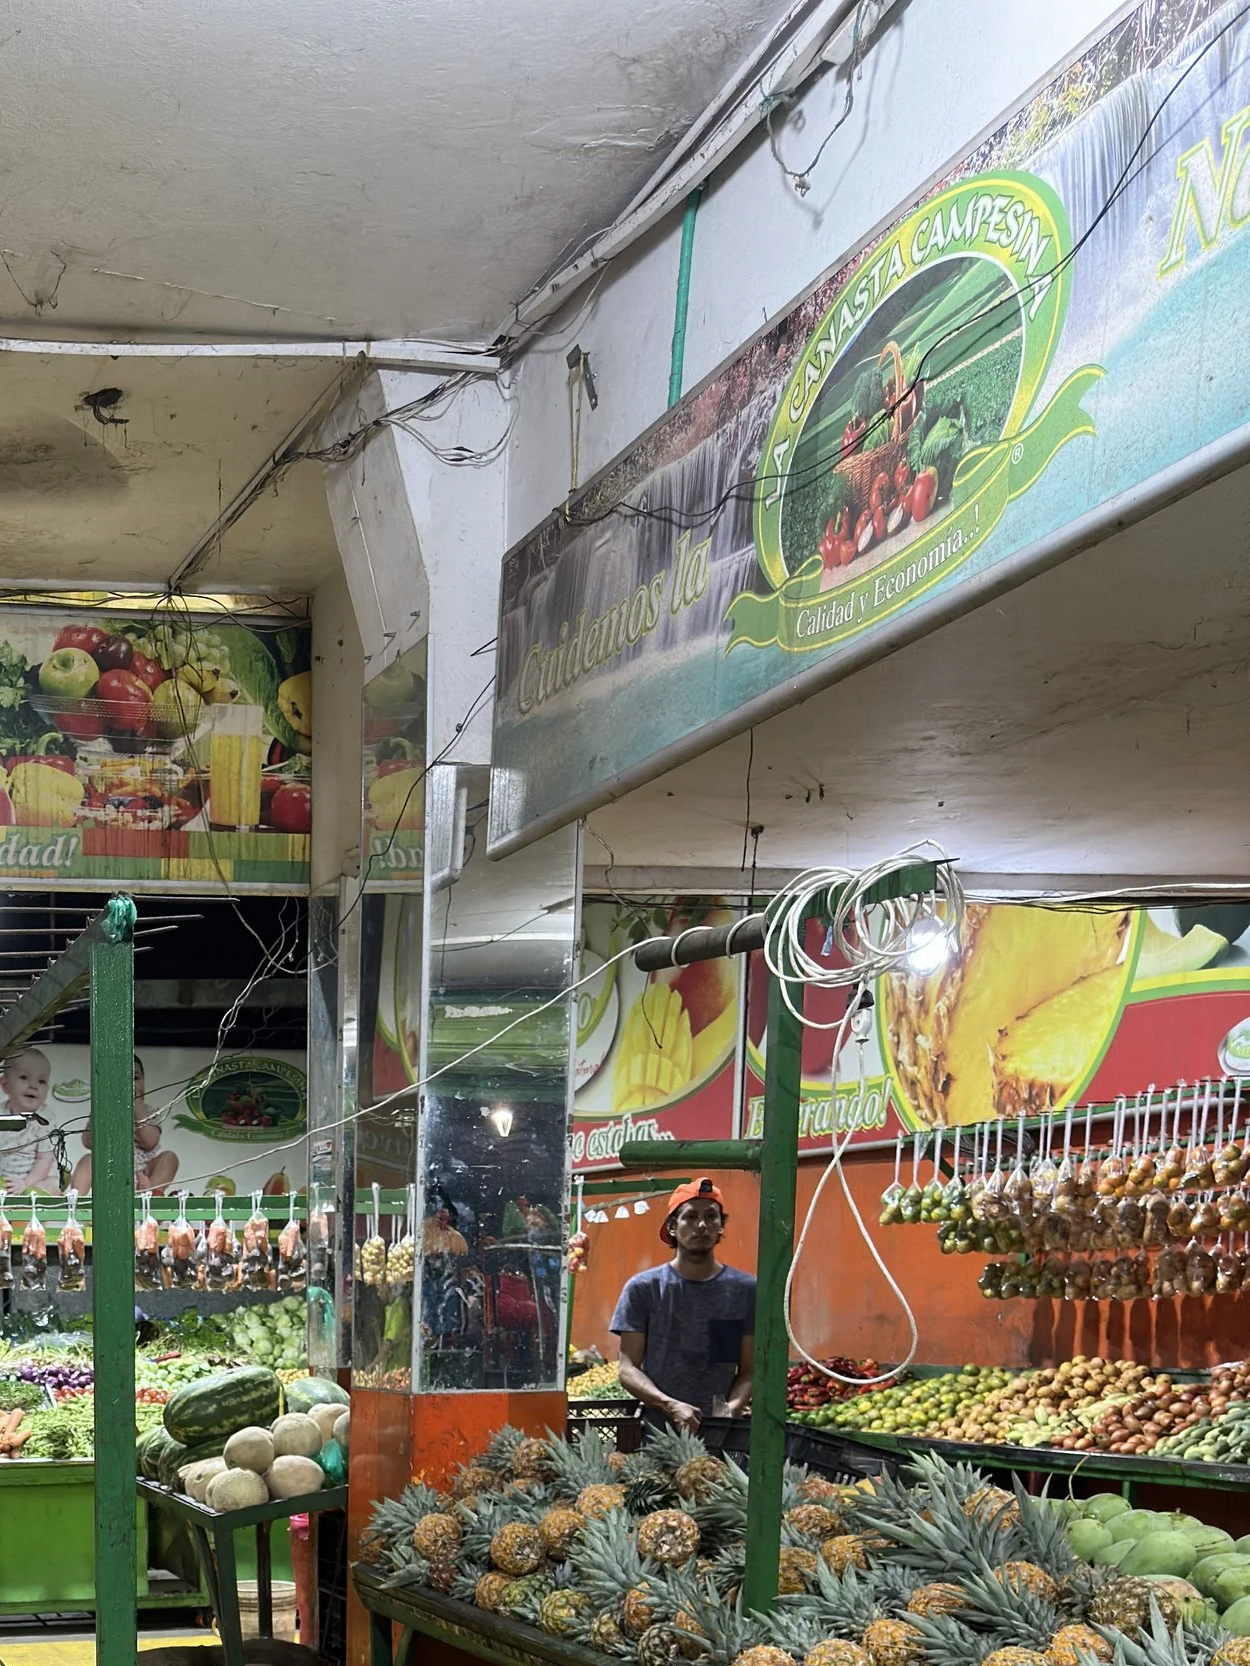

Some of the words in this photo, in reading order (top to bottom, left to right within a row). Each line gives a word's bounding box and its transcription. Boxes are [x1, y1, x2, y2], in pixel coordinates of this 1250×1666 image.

[764, 437, 791, 509] LA
[788, 240, 906, 424] CANASTA
[910, 191, 1054, 323] CAMPESINA
[517, 569, 666, 717] Cuidemos
[669, 528, 713, 617] la
[796, 592, 855, 638] Calidad
[857, 593, 870, 624] y
